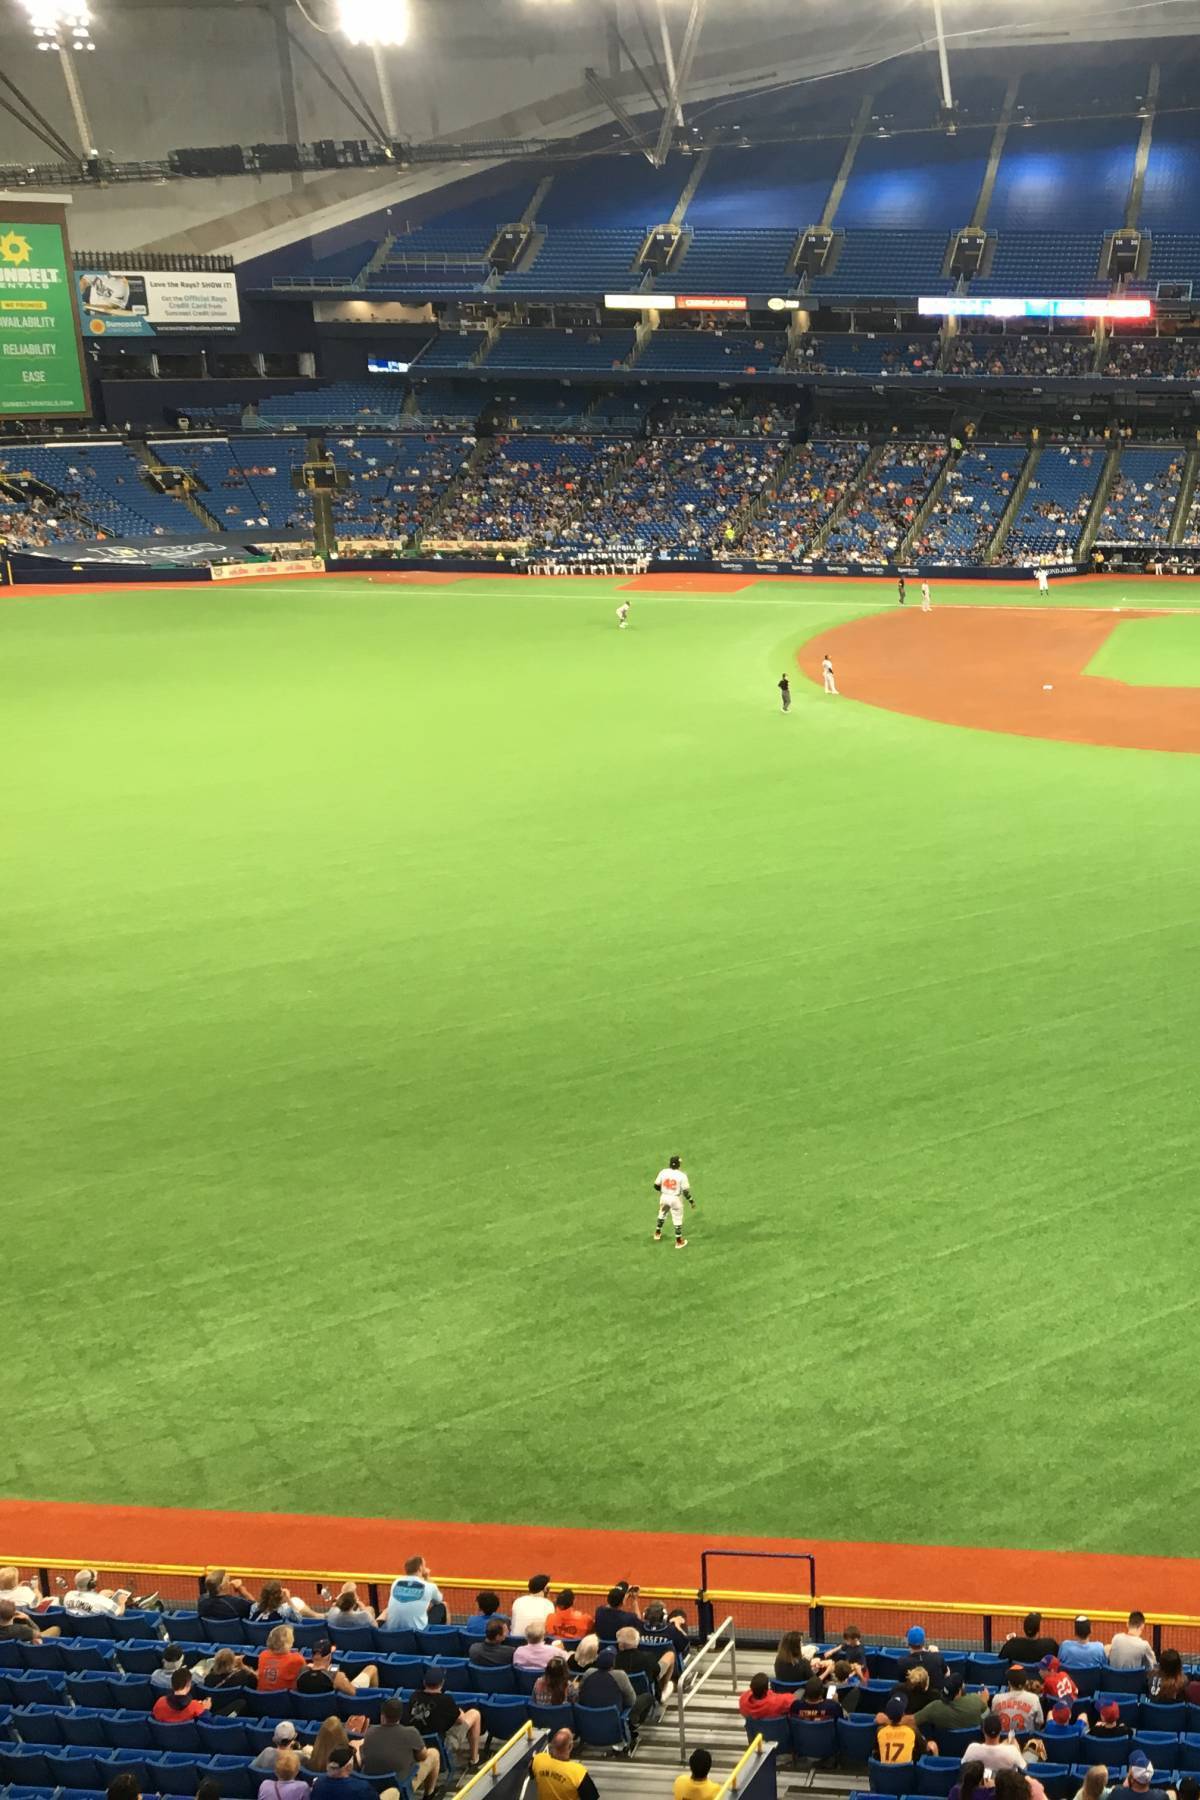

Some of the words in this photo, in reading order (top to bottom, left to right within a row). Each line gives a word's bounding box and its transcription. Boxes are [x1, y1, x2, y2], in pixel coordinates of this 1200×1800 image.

[3, 344, 56, 355] RELIABILITY
[22, 371, 46, 382] EASE
[663, 1178, 677, 1190] 42
[1056, 1677, 1072, 1698] 23
[885, 1742, 905, 1762] 17
